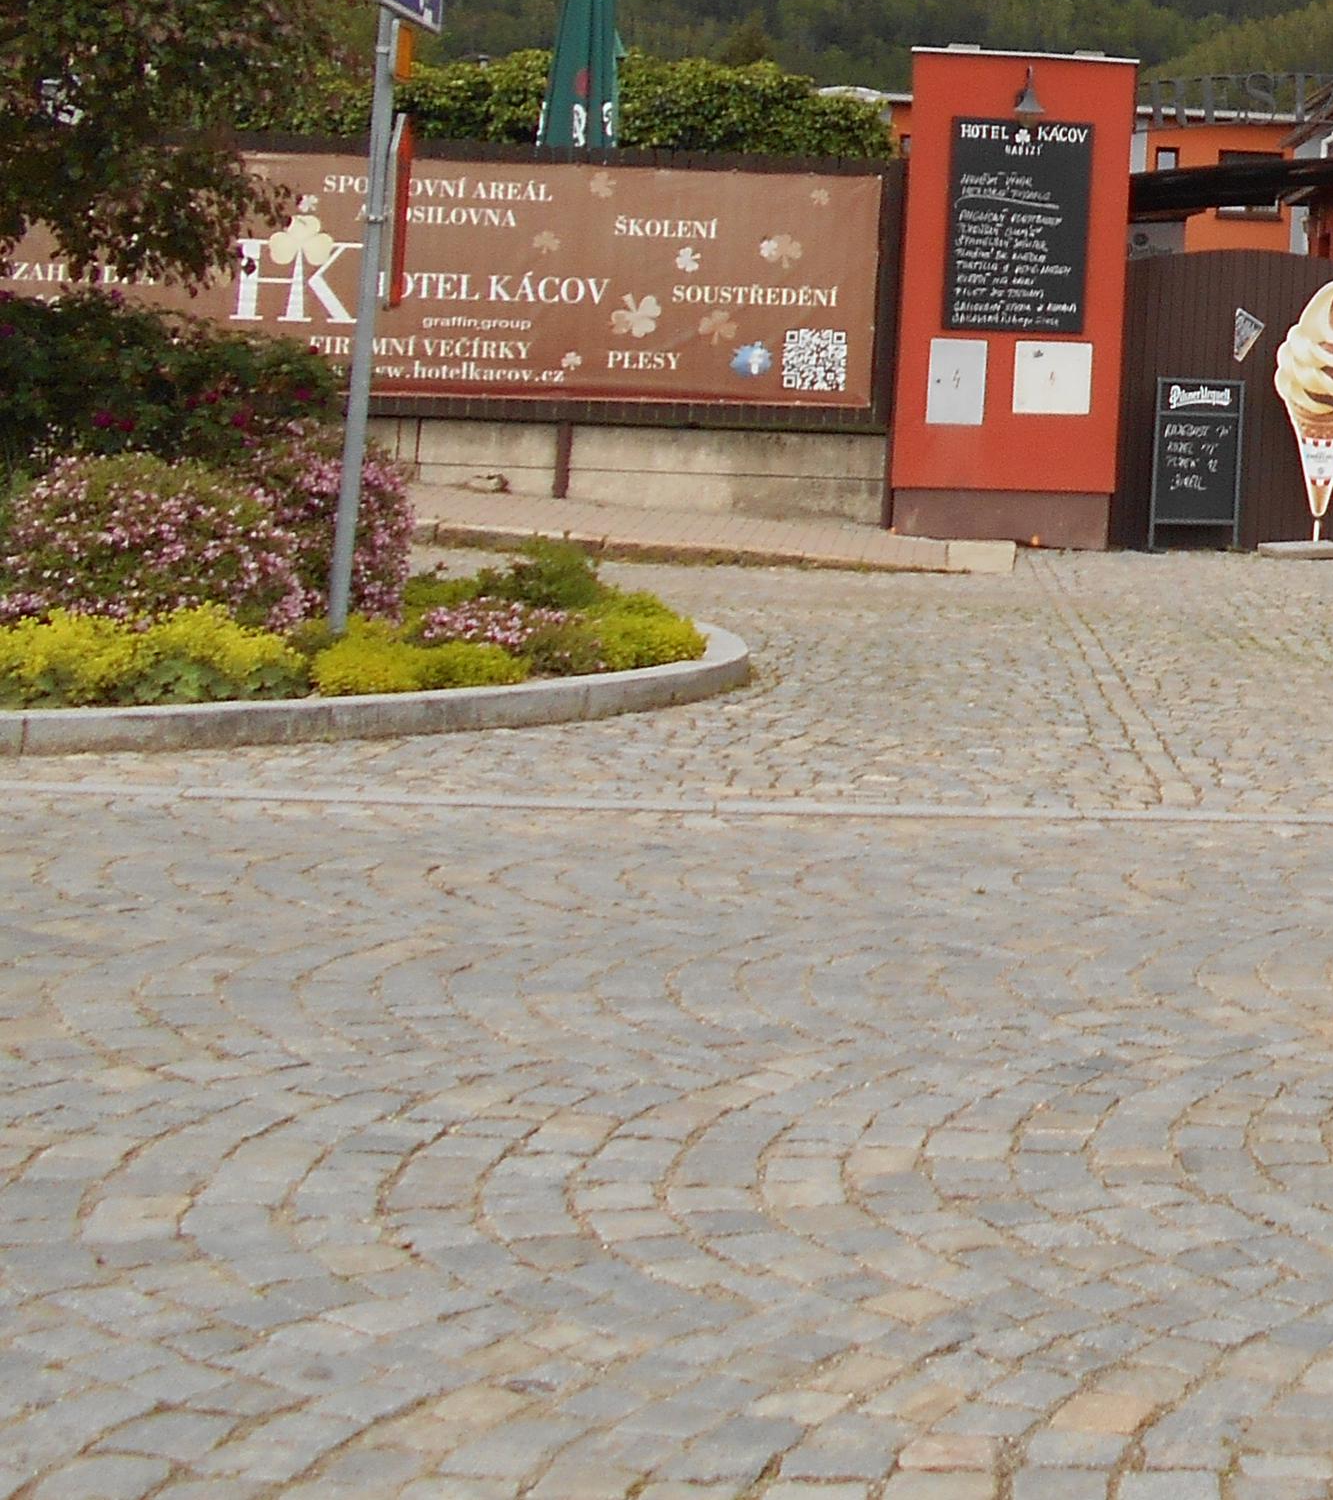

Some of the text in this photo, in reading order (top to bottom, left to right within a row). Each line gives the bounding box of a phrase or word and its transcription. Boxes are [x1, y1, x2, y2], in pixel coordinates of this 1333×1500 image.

[960, 123, 1088, 144] HOTEL KÁCOV
[322, 174, 553, 202] SPOOVNÍ AREÁL
[405, 205, 517, 228] SILOVNA
[614, 214, 719, 240] ŠKOLENÍ
[487, 270, 611, 305] KÁCOV
[671, 283, 839, 308] SOUSTŘEDĚNÍ
[309, 334, 532, 360] FIRMNÍ VEČÍRKY
[606, 350, 682, 371] PLESY
